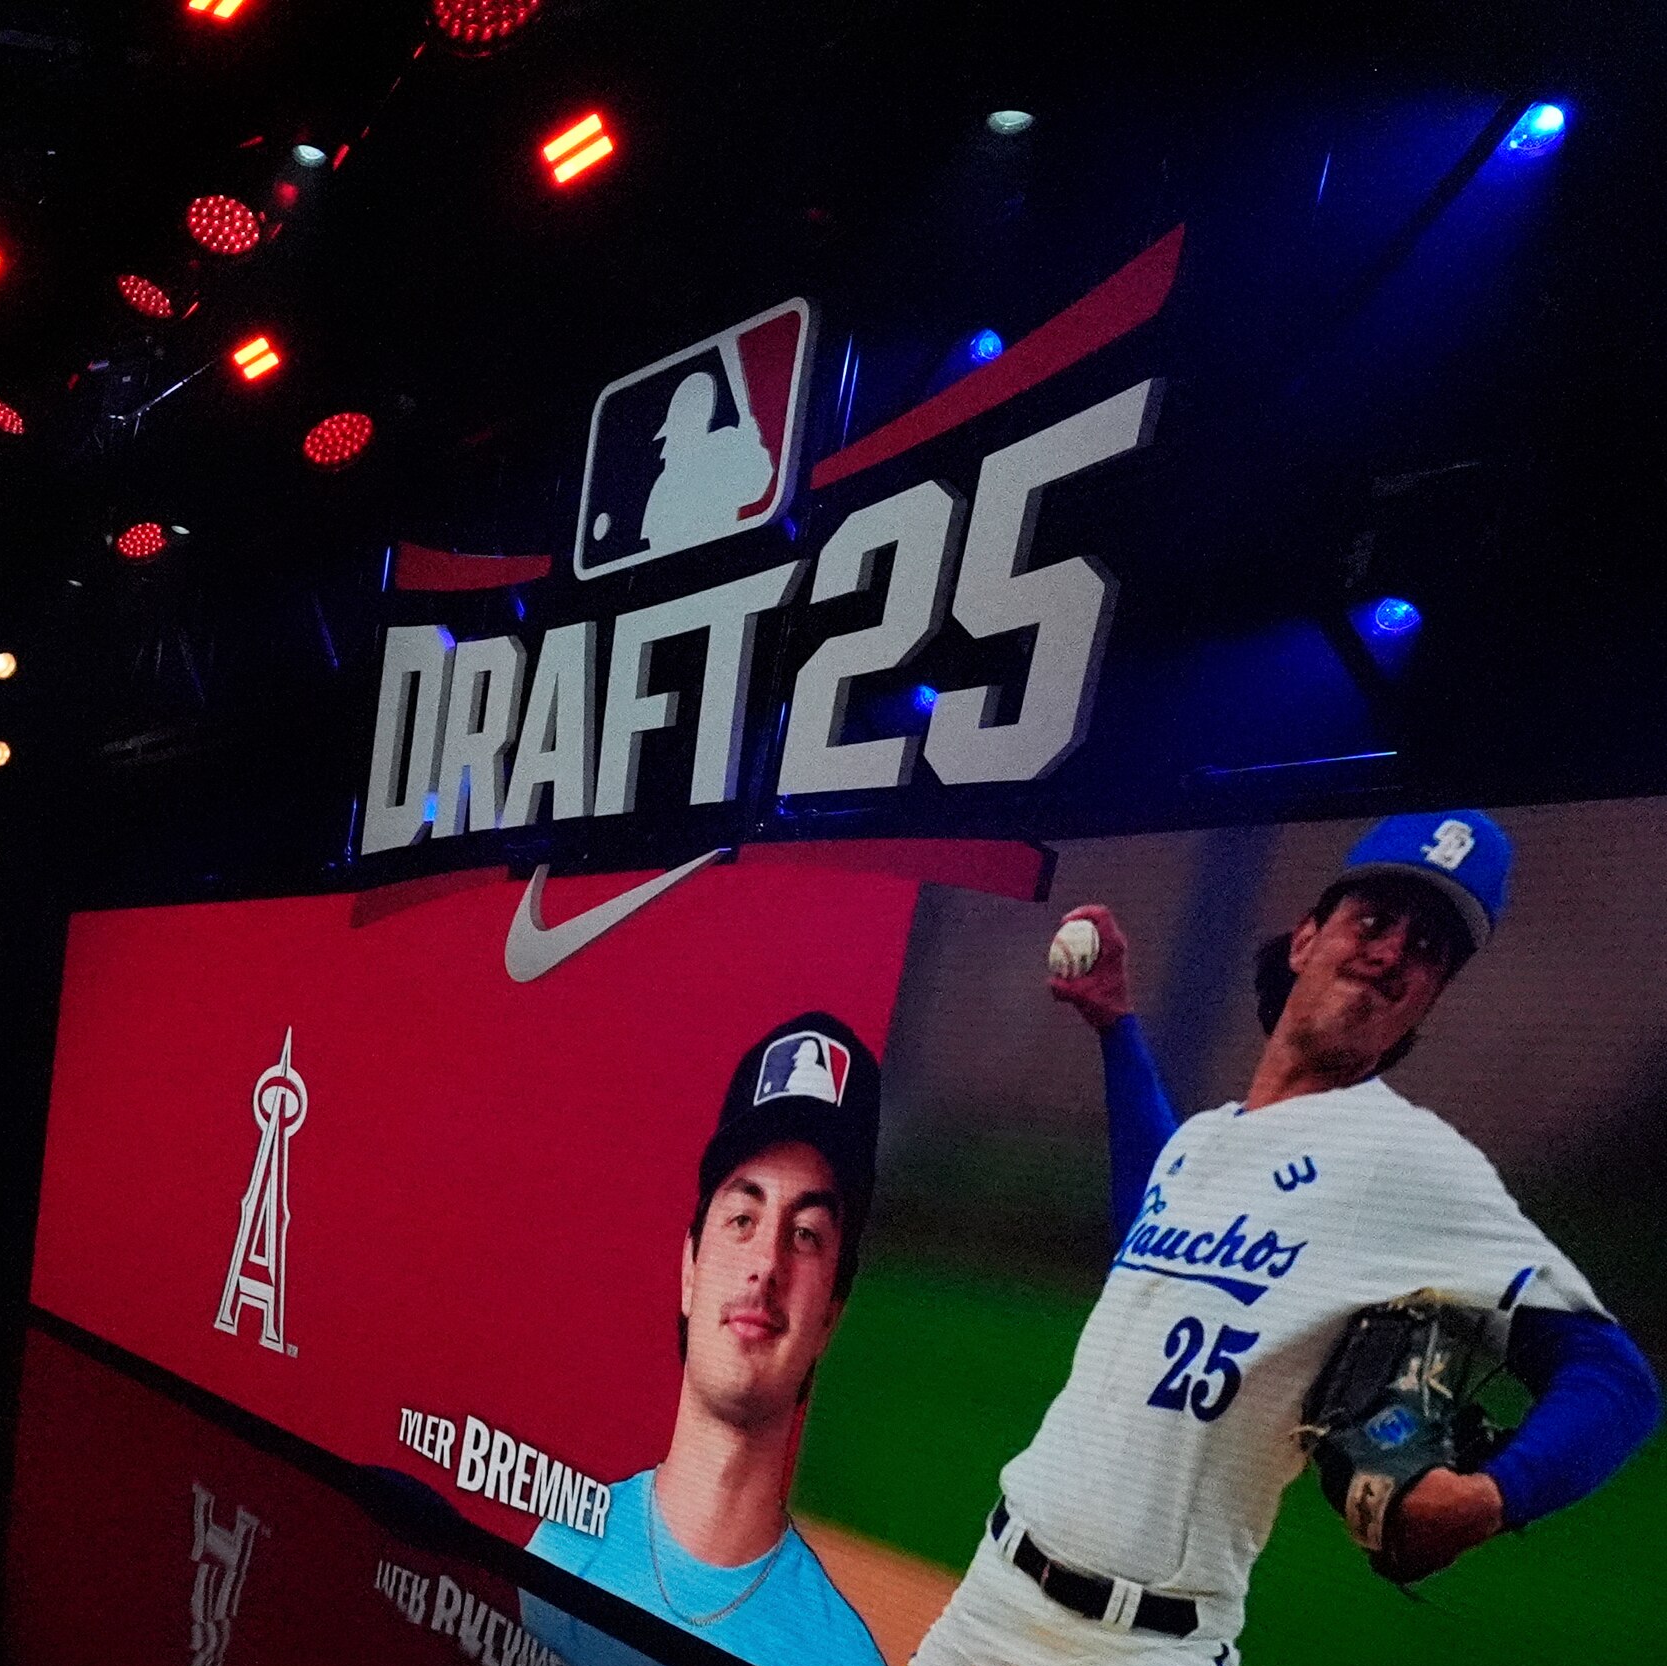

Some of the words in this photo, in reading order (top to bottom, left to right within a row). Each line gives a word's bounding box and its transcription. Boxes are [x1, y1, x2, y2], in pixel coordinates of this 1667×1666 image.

[360, 558, 811, 857] DRAFT
[775, 376, 1167, 797] 25
[1147, 1316, 1260, 1422] 25
[398, 1407, 456, 1469] TYLER
[456, 1415, 611, 1538] BREMNER
